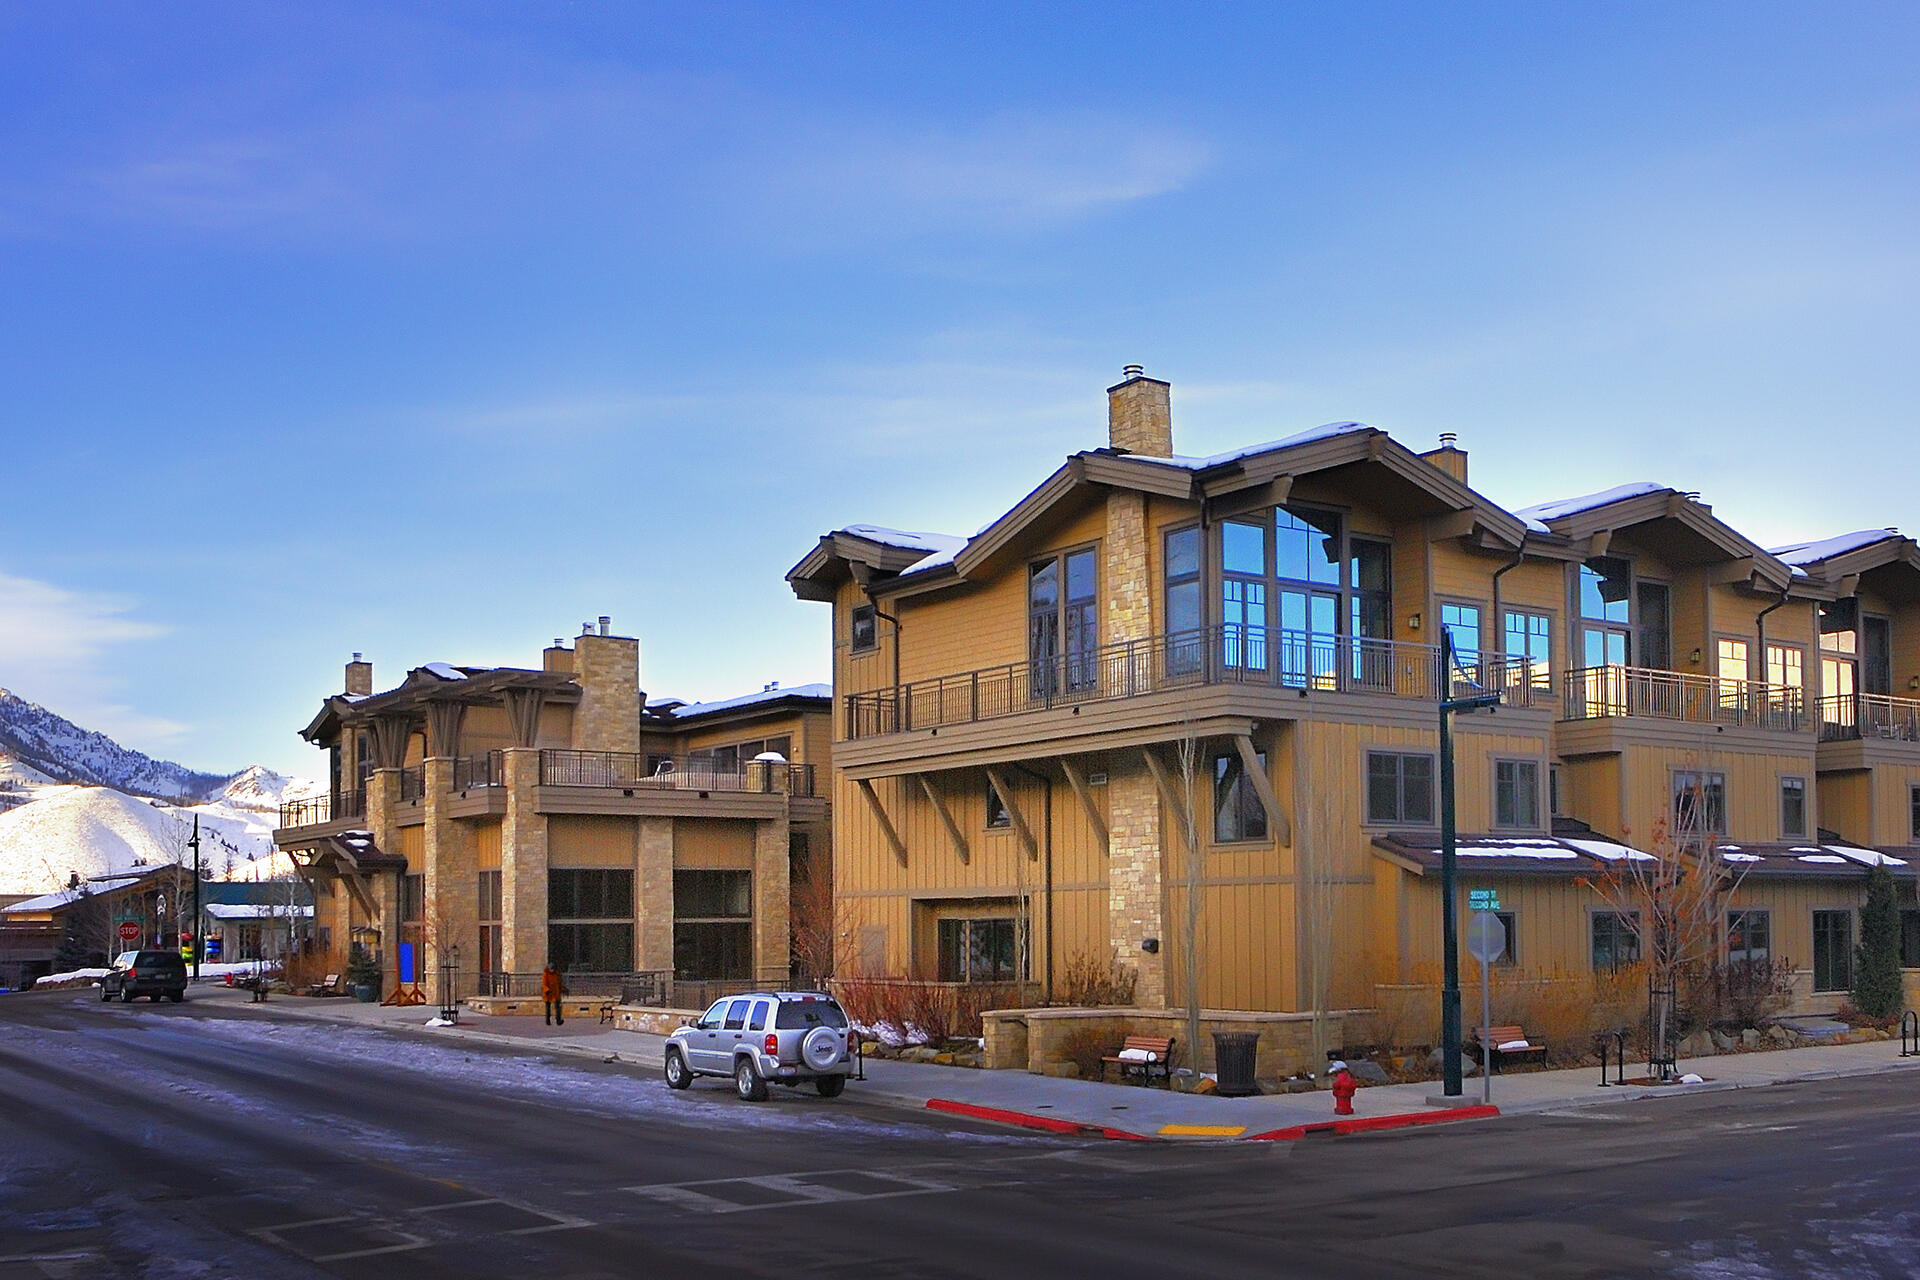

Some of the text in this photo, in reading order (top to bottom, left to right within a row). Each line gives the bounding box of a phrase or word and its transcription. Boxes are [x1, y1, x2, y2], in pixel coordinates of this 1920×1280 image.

[1470, 890, 1490, 899] SECOND
[1469, 900, 1501, 910] SECOND AVE
[120, 927, 138, 935] STOP
